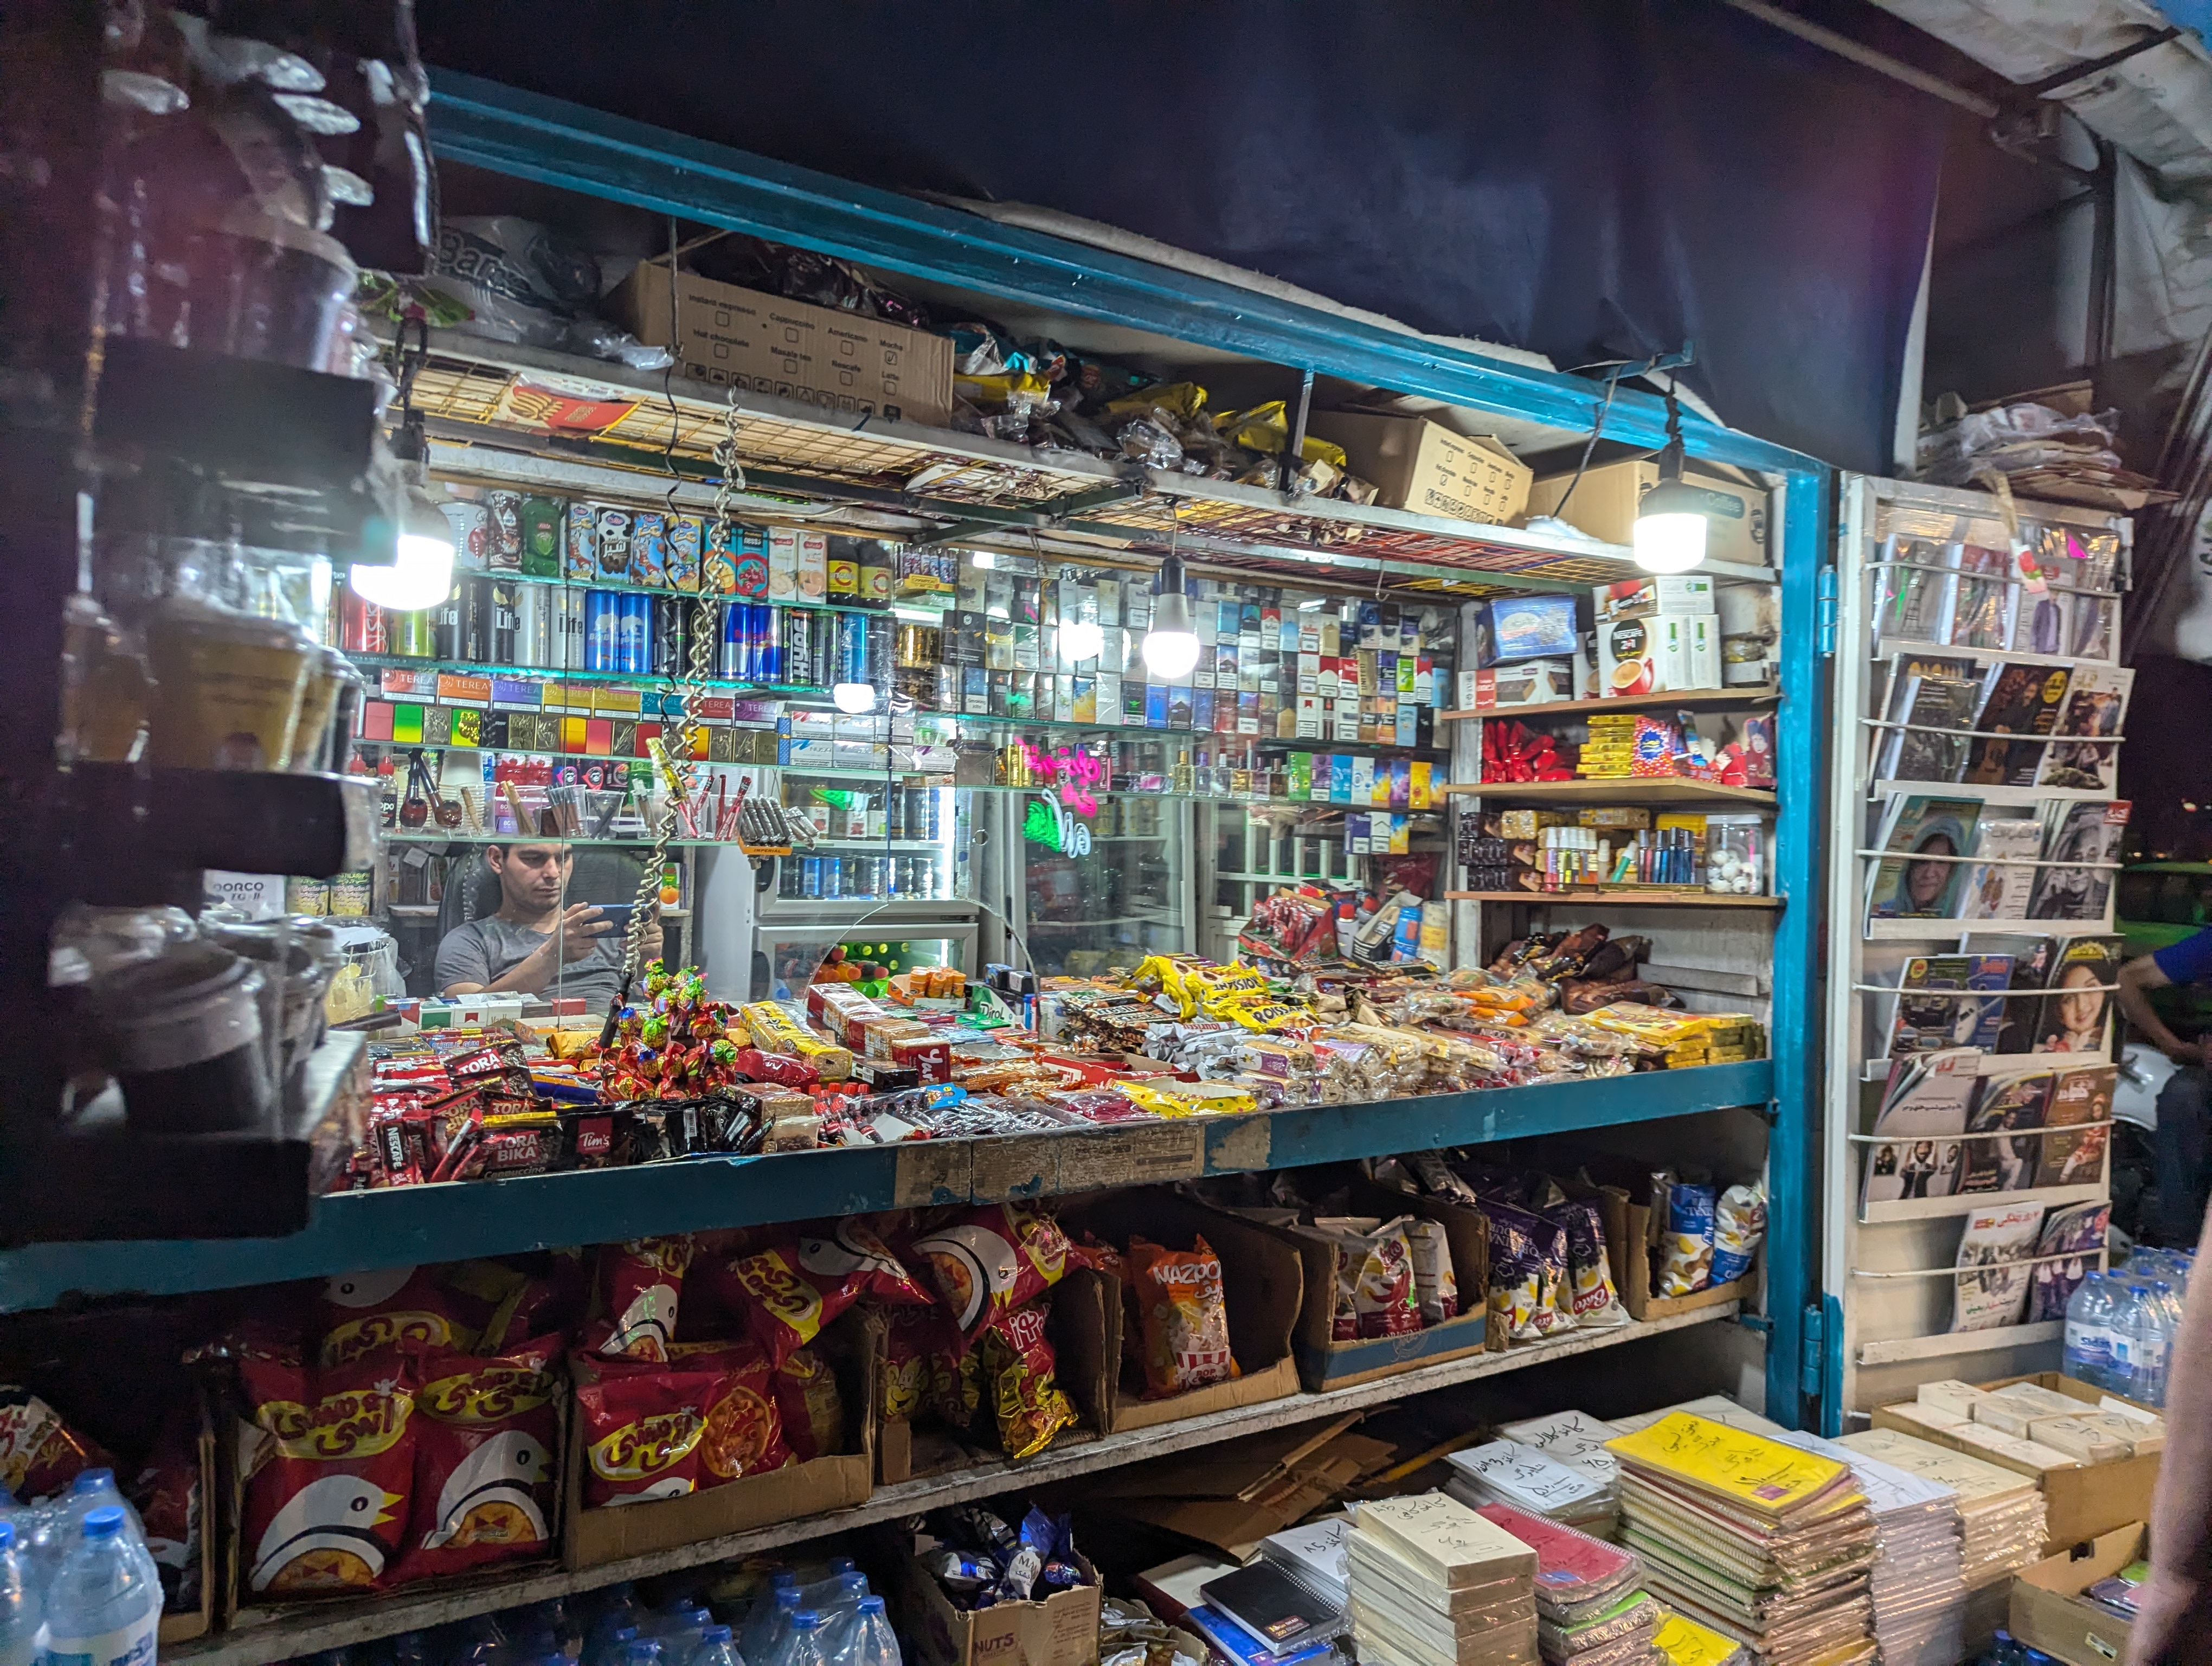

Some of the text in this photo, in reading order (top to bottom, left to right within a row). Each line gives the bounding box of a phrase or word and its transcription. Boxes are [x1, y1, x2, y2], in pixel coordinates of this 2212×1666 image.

[603, 541, 626, 558] شیر
[400, 674, 434, 684] TEREA
[456, 680, 488, 690] TEREA
[510, 685, 539, 694] TEREA
[704, 699, 731, 709] TEREA
[748, 703, 776, 713] TEREA
[1252, 1004, 1310, 1024] ROISSANT
[458, 1053, 500, 1074] TORA
[492, 1103, 531, 1114] TORA
[580, 1131, 611, 1146] Tim's
[497, 1146, 537, 1163] BIKA
[1153, 1260, 1222, 1285] MAZPO
[1197, 1367, 1217, 1376] POP
